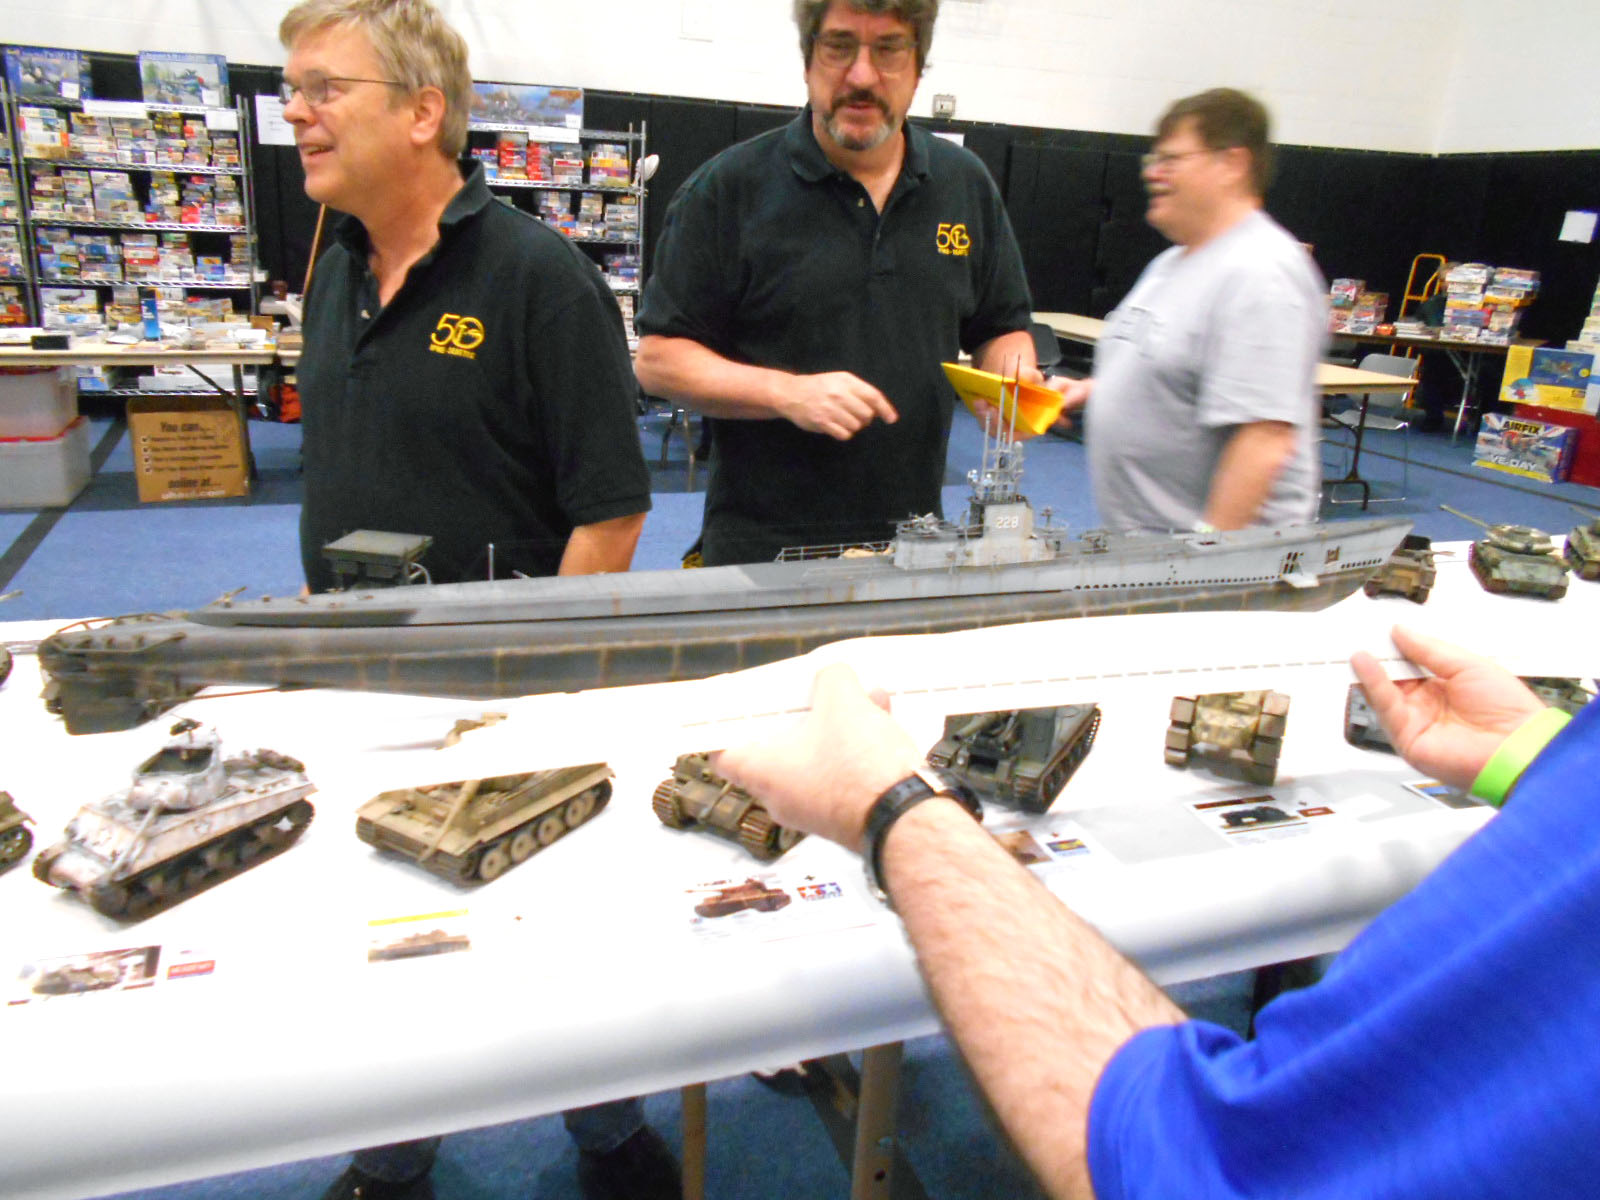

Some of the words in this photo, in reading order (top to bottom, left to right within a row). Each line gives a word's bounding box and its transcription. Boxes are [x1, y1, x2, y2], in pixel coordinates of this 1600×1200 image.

[160, 422, 178, 432] You
[1503, 419, 1541, 434] AIRFIX
[996, 515, 1019, 529] 228
